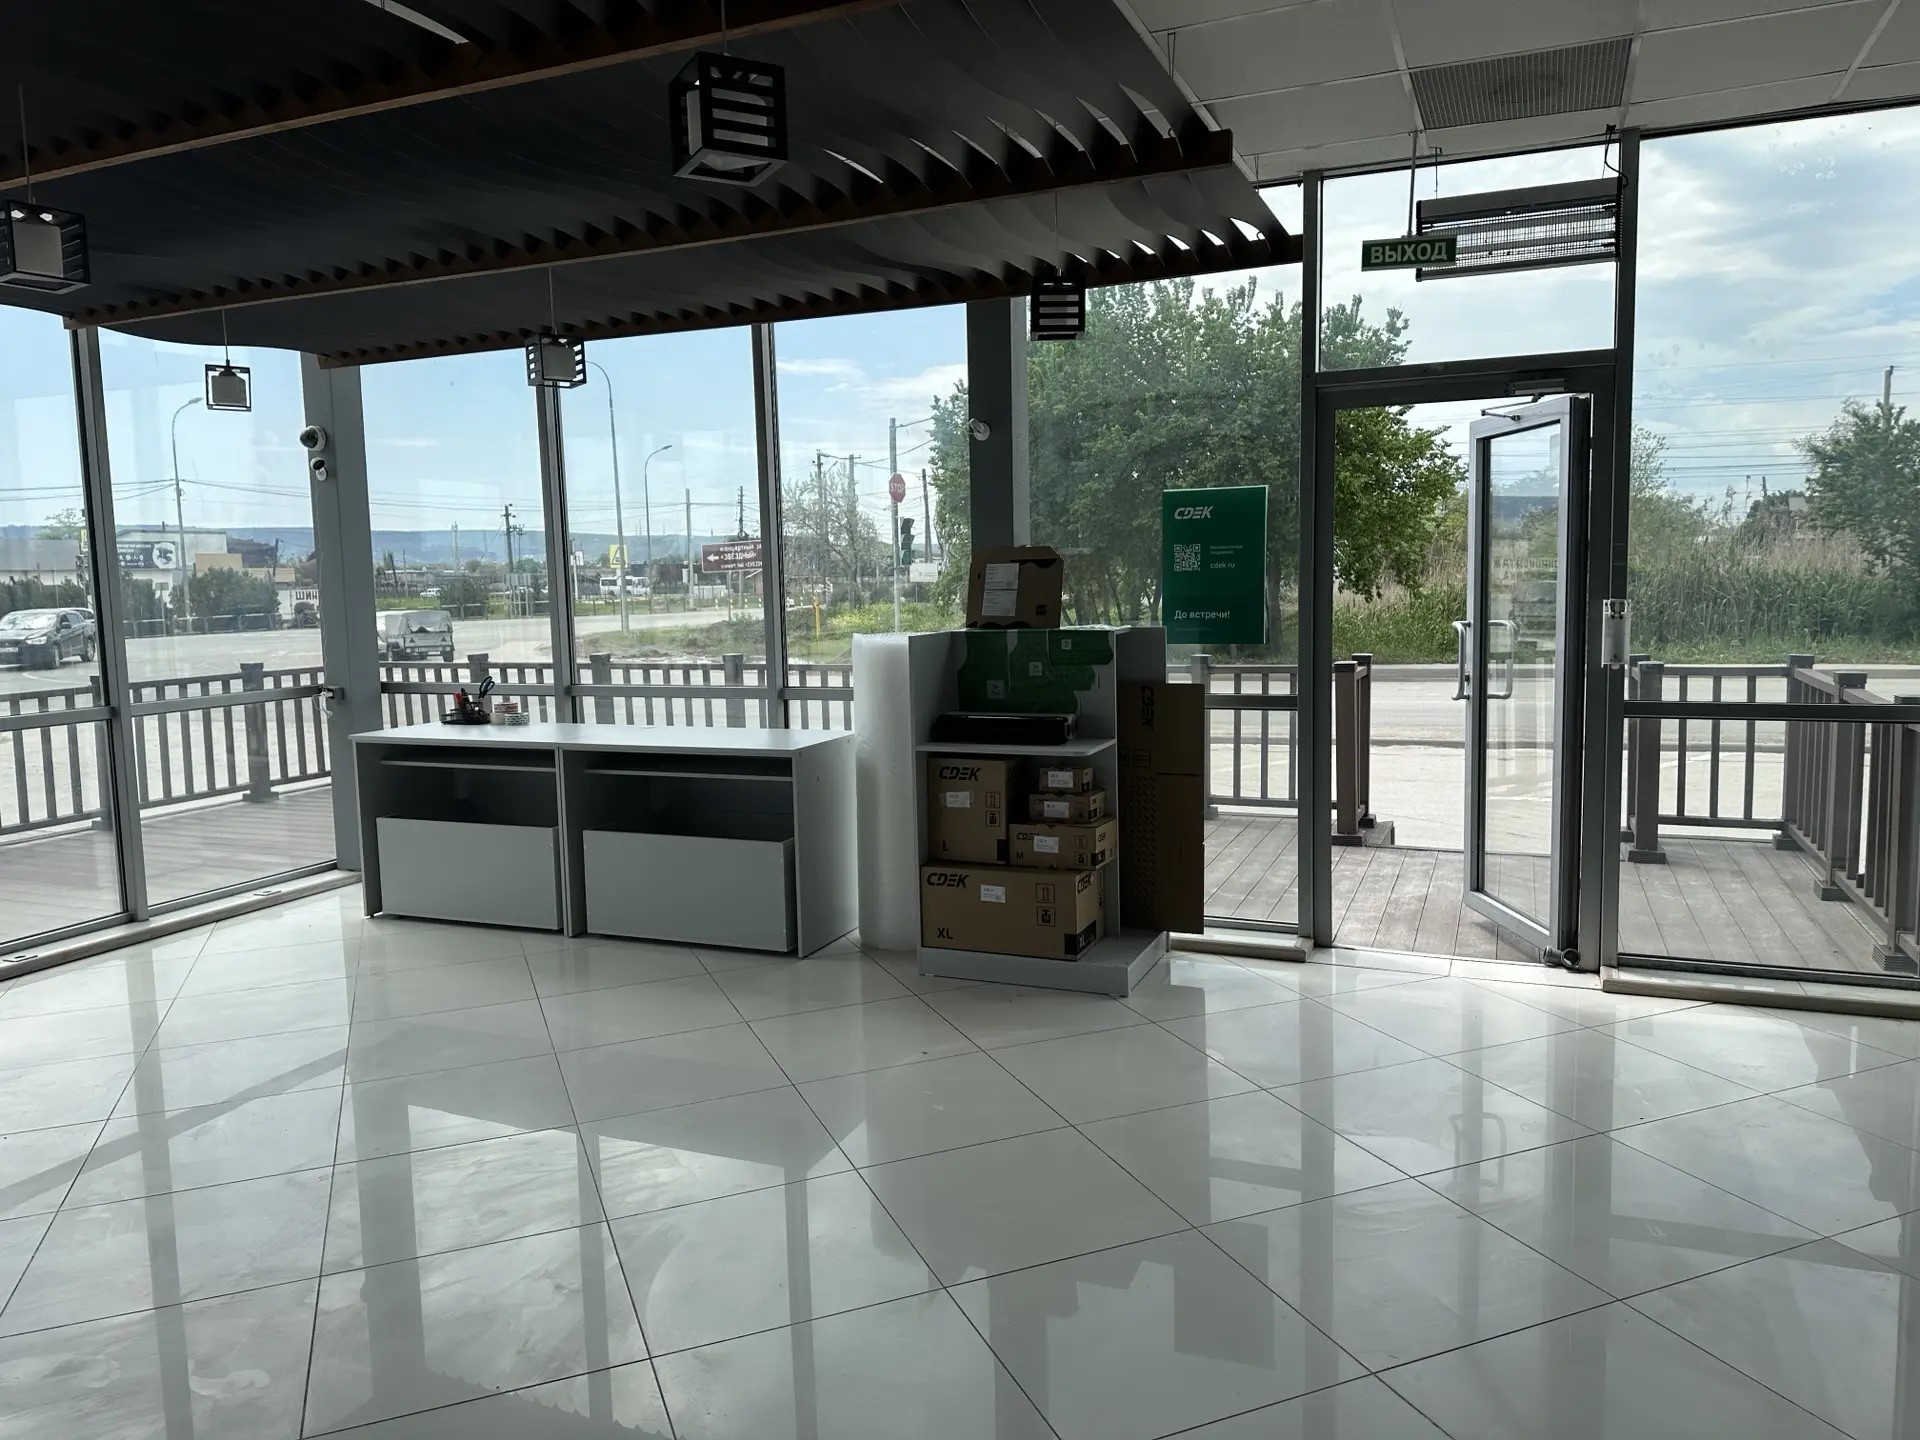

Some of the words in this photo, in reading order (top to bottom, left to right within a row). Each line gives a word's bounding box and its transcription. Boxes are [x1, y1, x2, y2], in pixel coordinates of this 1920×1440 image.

[1370, 242, 1448, 264] ВЫХОД
[890, 483, 904, 492] STOP
[1174, 506, 1214, 520] CDEK
[1174, 610, 1187, 621] До
[1189, 610, 1231, 621] встречи!
[938, 766, 982, 781] CDEK
[942, 839, 949, 851] L
[1016, 852, 1024, 861] M
[927, 872, 970, 889] CDEK
[1077, 872, 1097, 894] CDEK
[936, 927, 954, 940] XL
